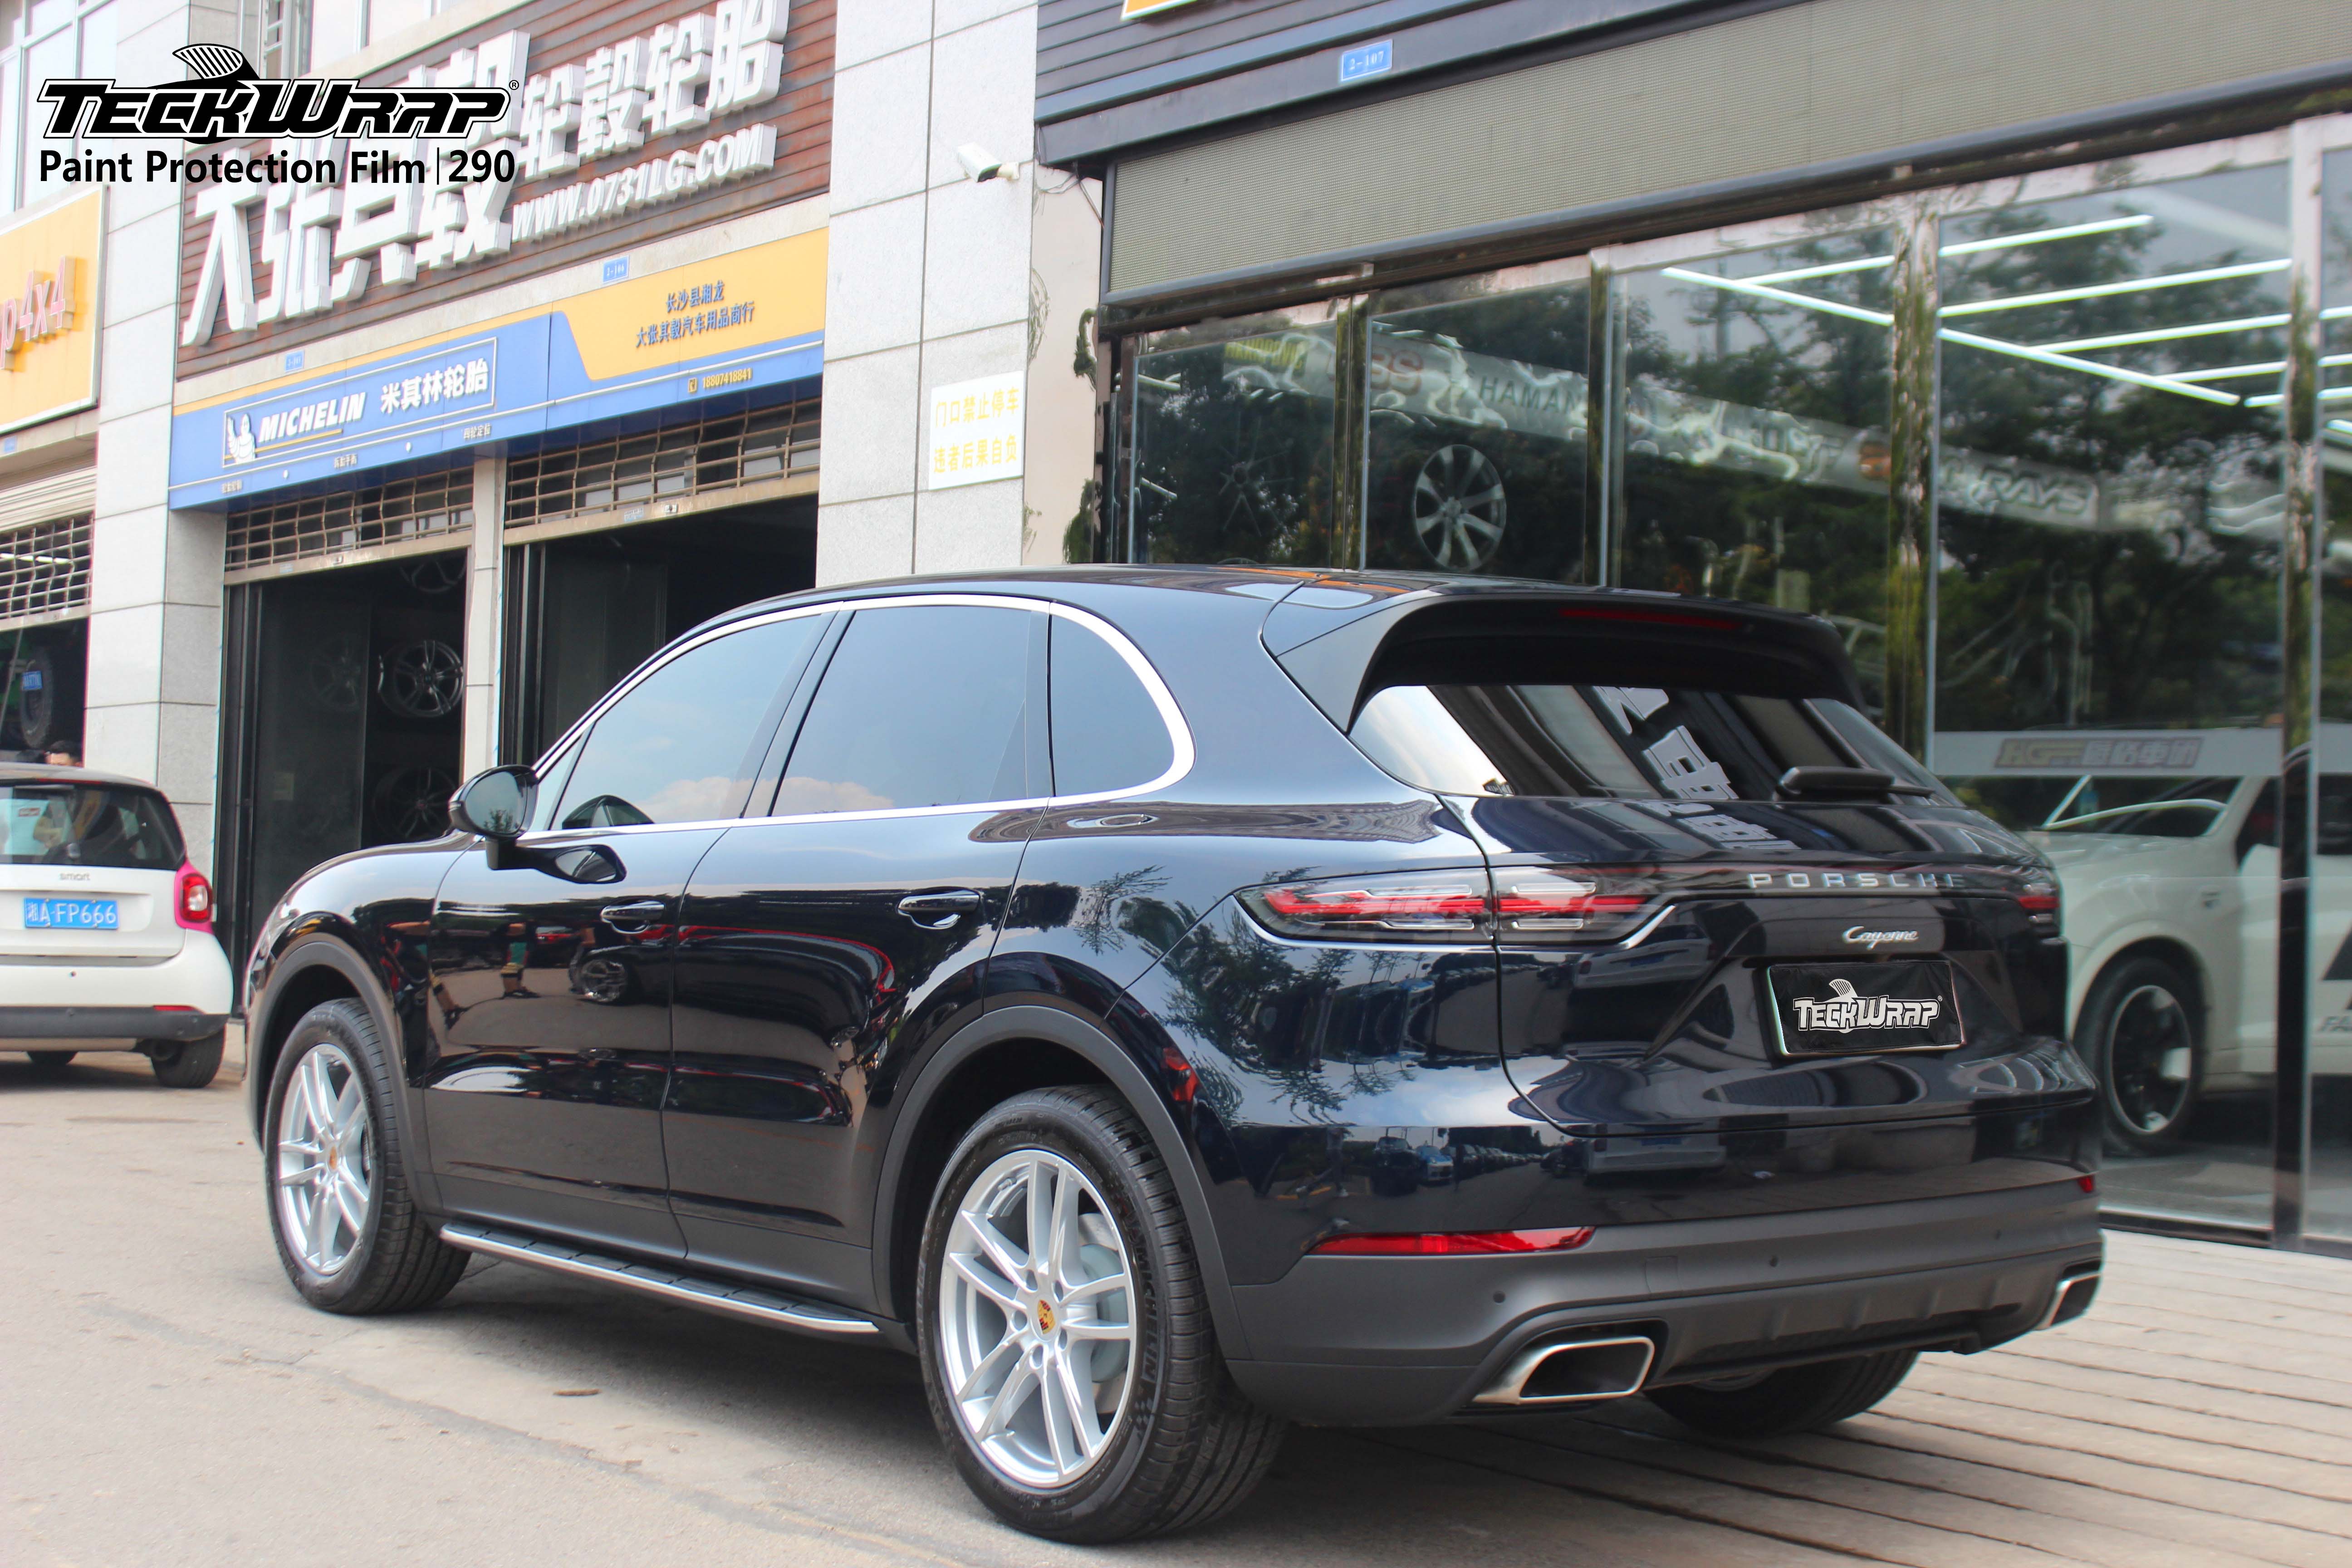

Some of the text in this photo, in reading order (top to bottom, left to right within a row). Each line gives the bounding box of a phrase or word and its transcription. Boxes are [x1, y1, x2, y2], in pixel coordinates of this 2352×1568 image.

[1347, 50, 1385, 70] 2-107
[665, 279, 725, 314] 长沙县湘龙
[380, 357, 489, 416] 米其林轮胎
[258, 392, 368, 443] MICHELIN
[935, 386, 1019, 428] 门口禁止停车
[933, 433, 1017, 474] 违者后果自负
[59, 872, 91, 881] smart
[1747, 872, 1966, 889] PORSCHE
[1842, 925, 1920, 950] Cayenne
